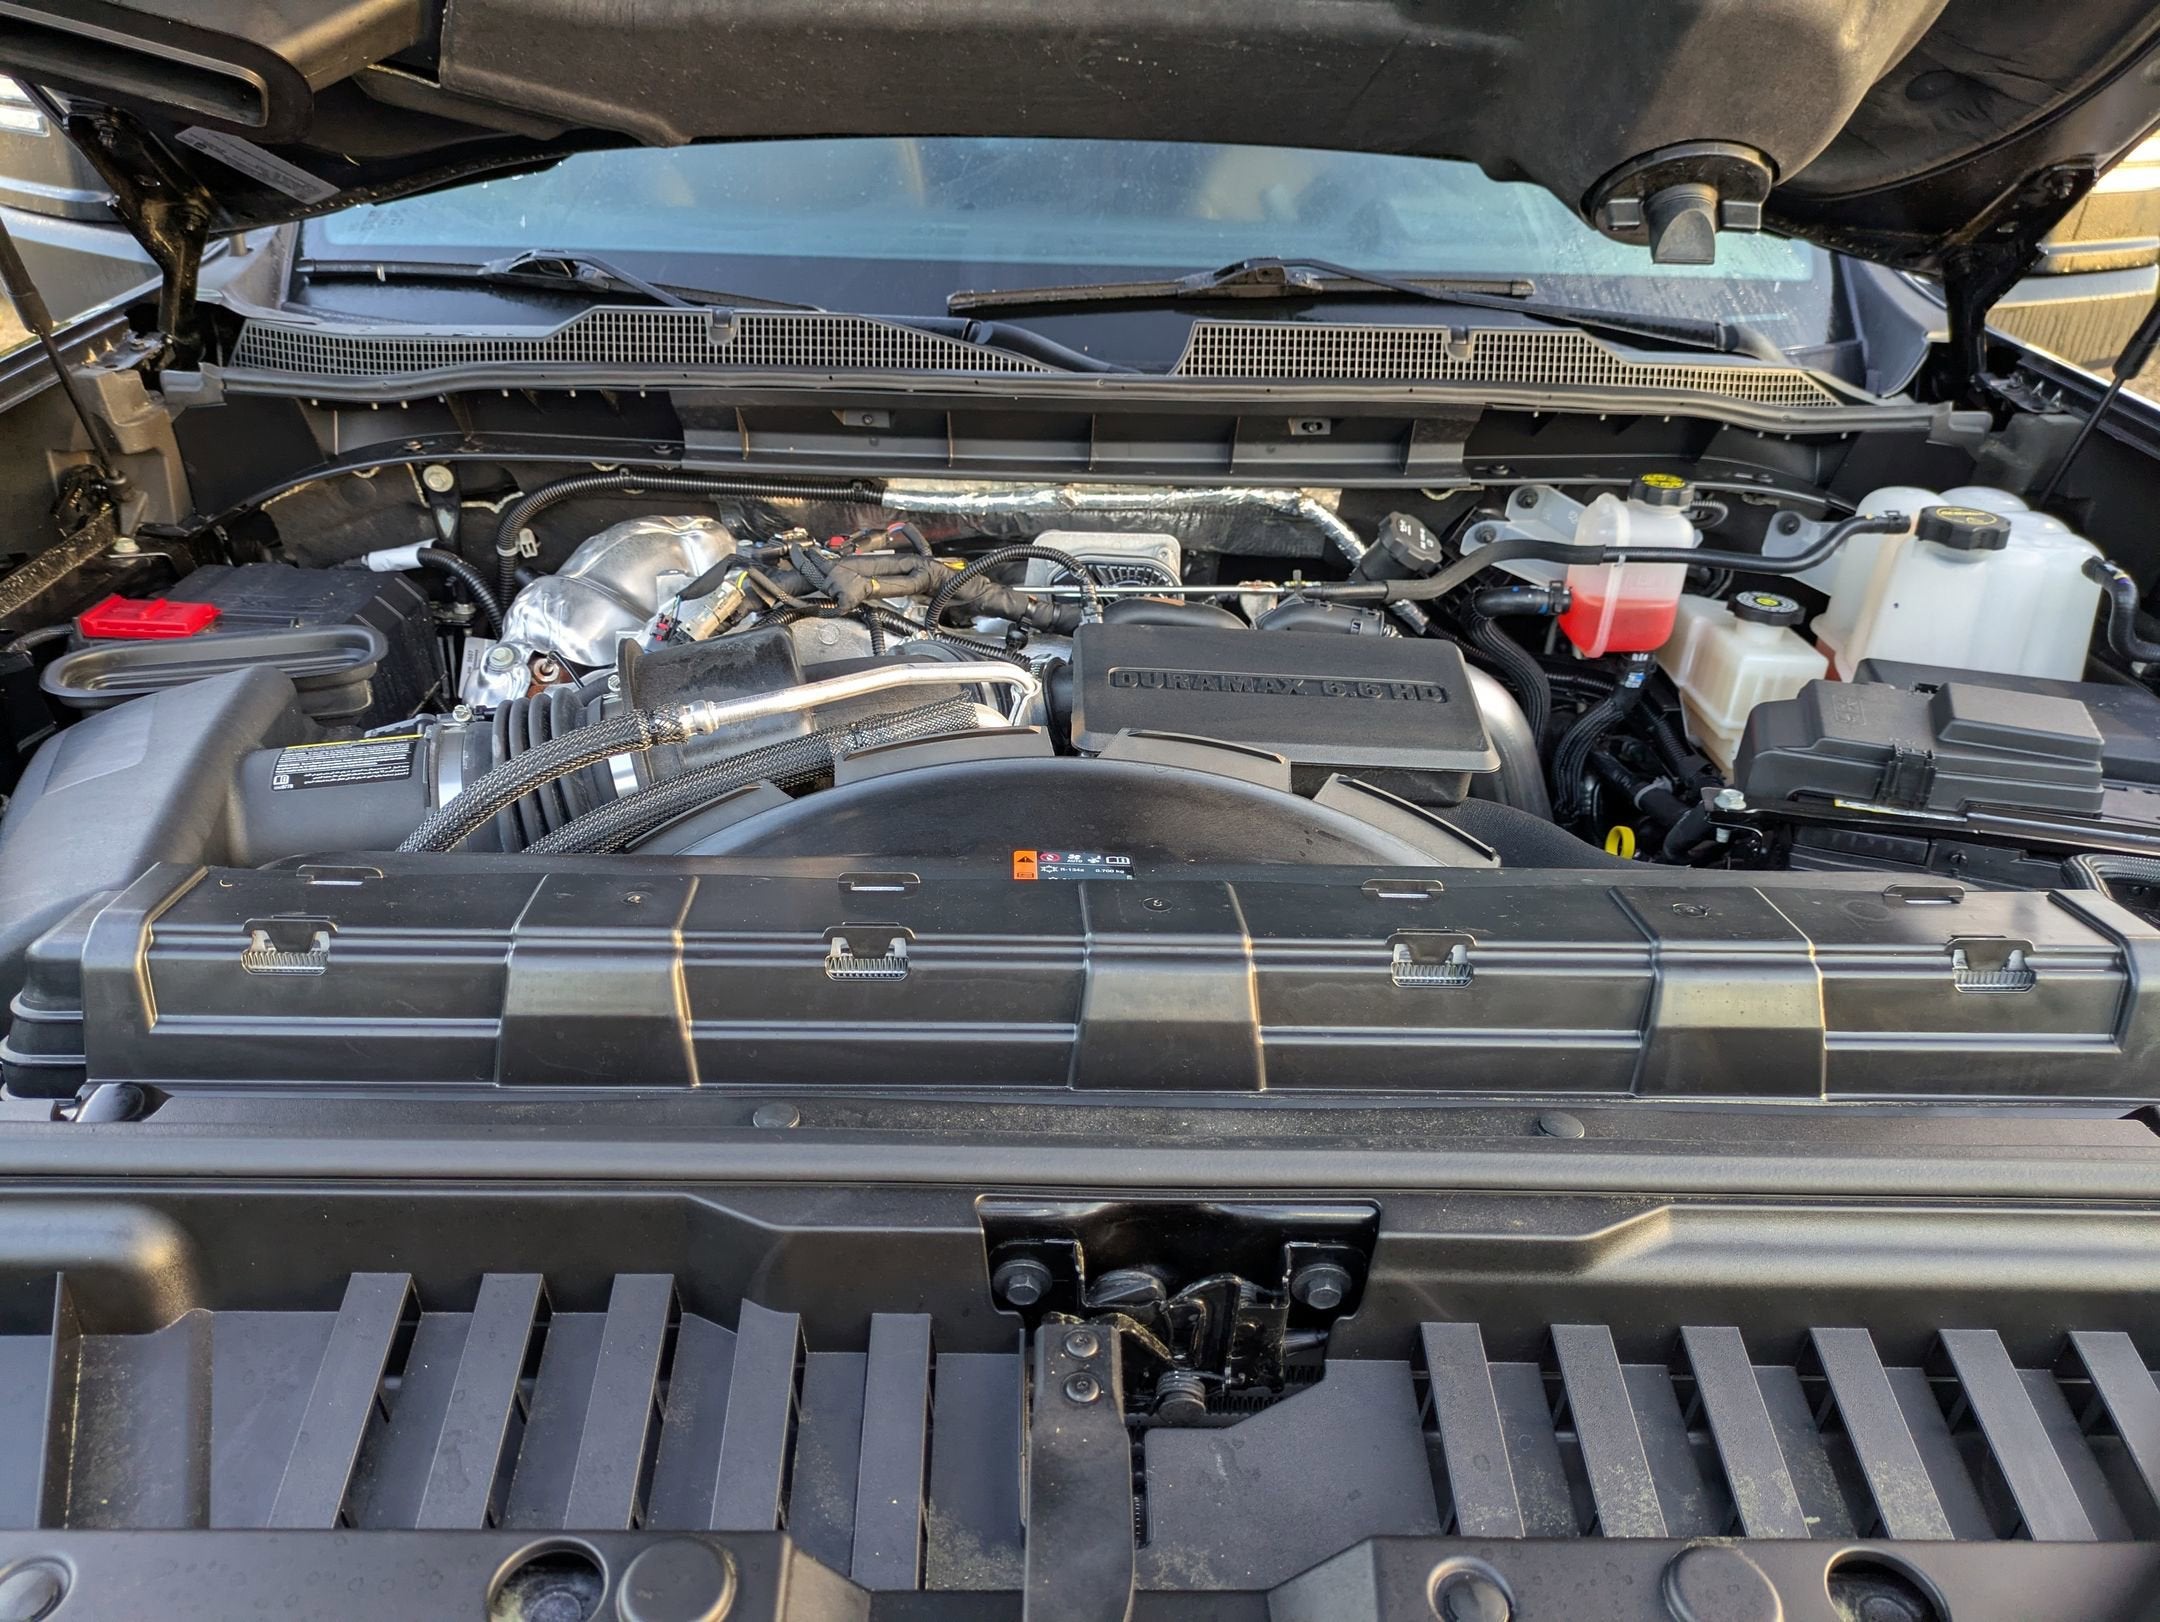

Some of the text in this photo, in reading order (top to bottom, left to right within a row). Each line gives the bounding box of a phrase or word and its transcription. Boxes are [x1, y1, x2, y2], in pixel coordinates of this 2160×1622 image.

[1114, 671, 1446, 703] DURAMAX 6.6 HD
